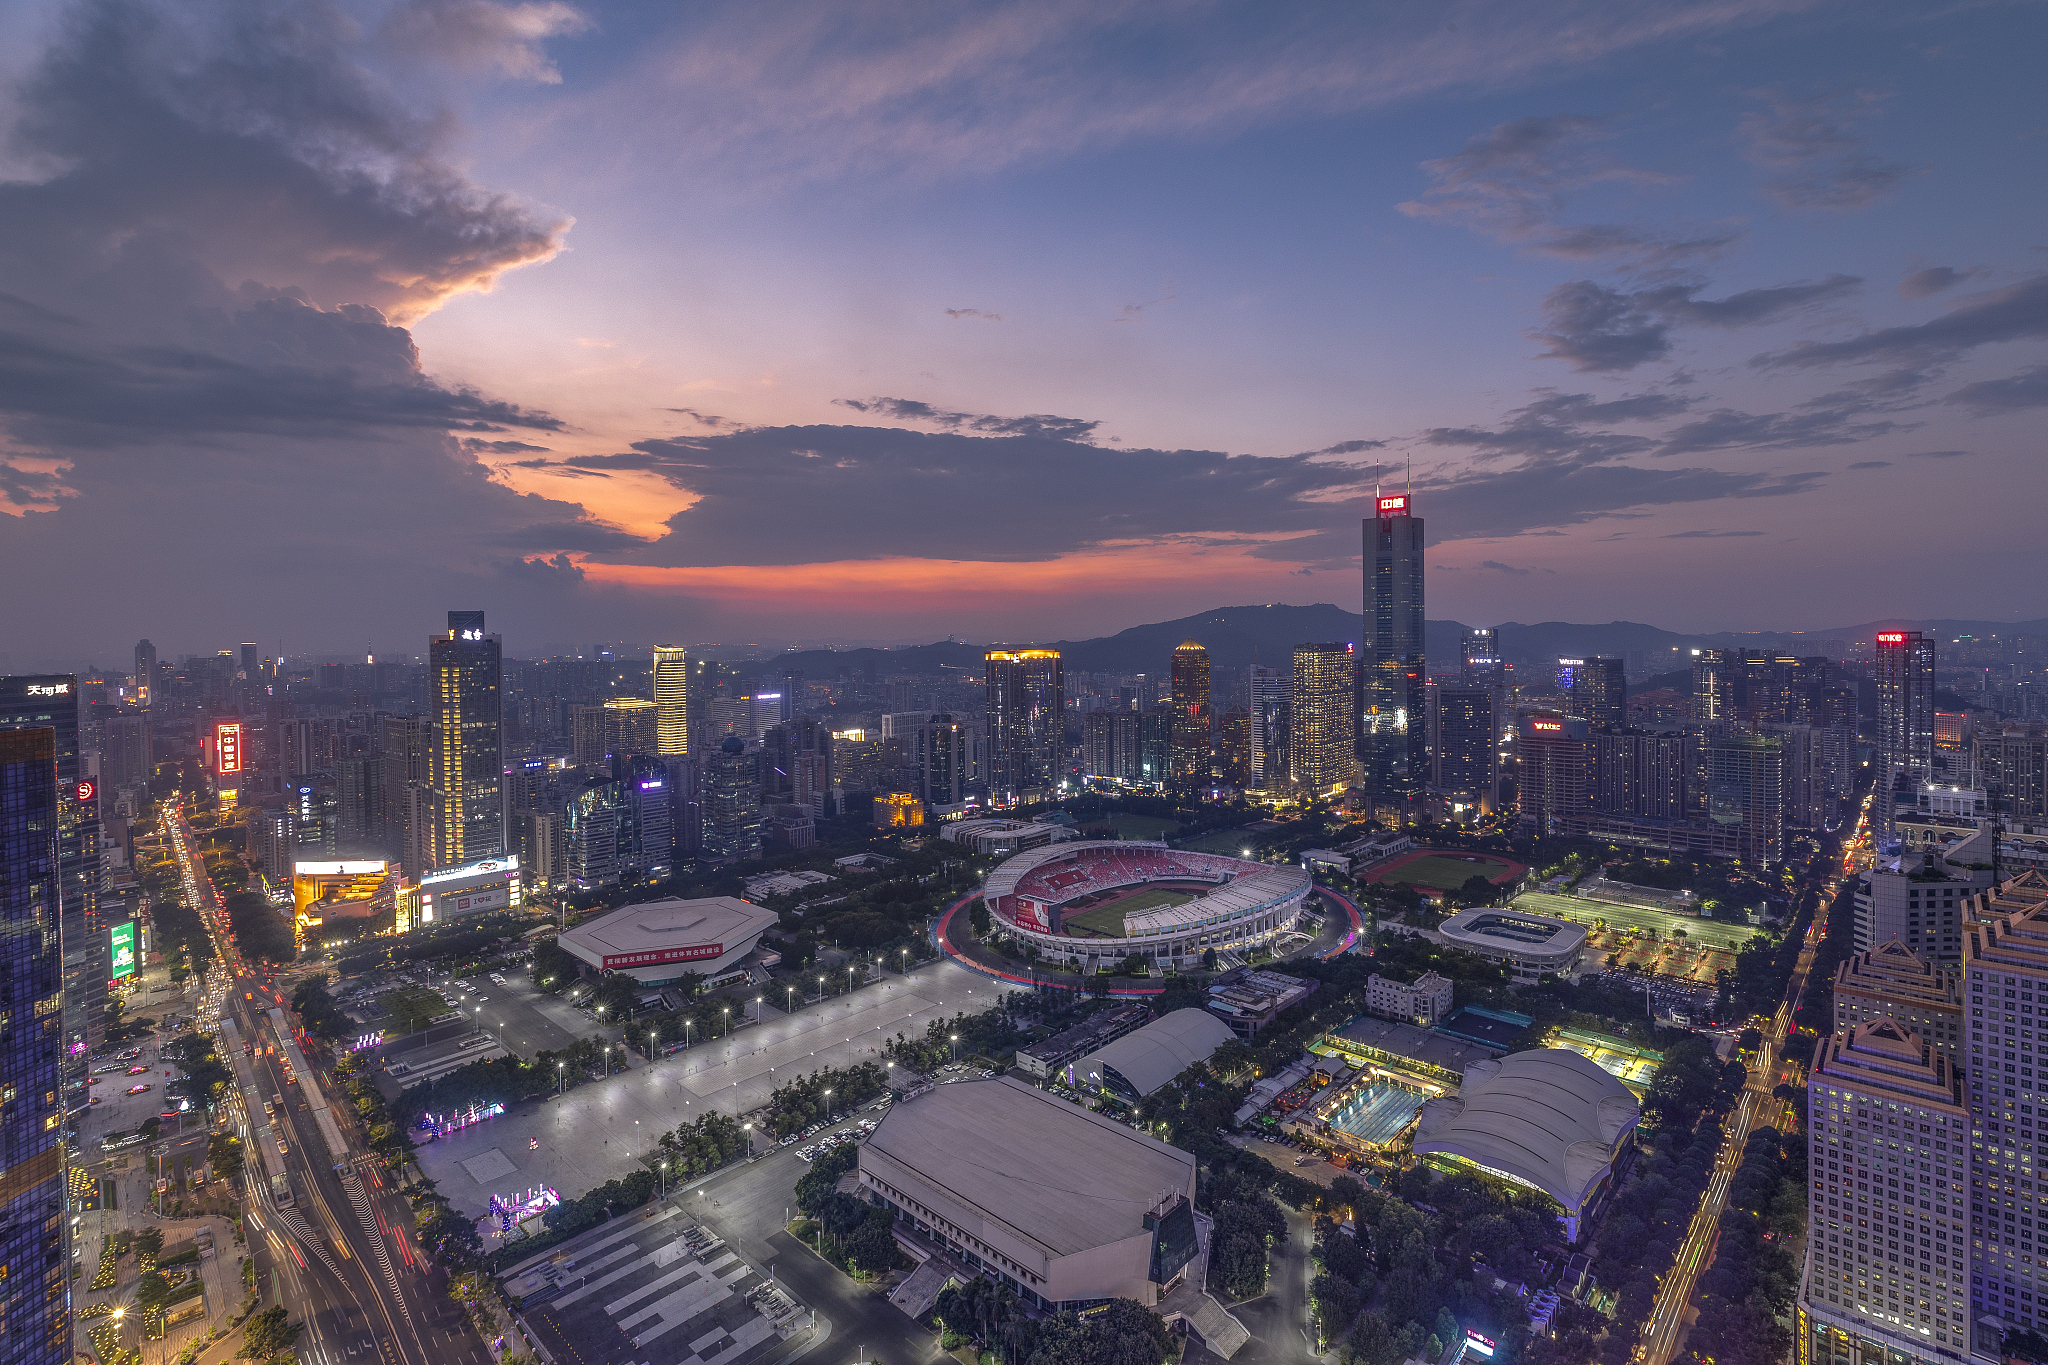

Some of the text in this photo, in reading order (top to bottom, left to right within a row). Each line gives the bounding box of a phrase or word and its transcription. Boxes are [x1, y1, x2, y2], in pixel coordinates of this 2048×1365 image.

[1381, 498, 1404, 509] 中信
[27, 684, 69, 697] 天河城
[223, 736, 235, 770] 中国平安
